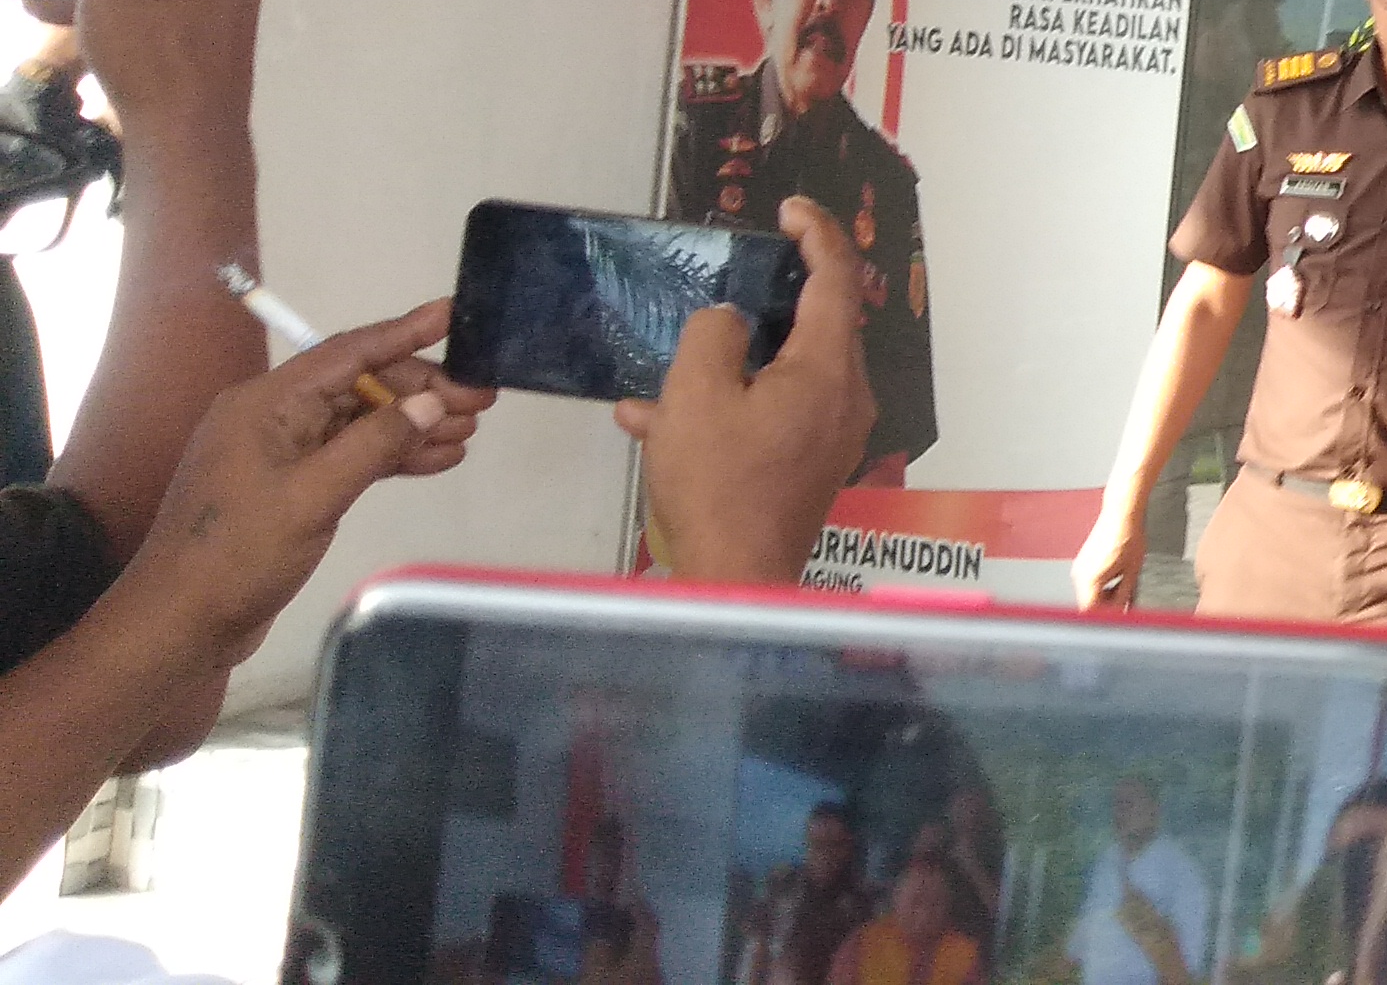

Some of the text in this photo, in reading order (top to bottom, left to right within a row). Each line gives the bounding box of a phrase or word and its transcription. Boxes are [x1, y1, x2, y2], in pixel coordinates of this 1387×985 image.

[1009, 4, 1180, 43] RASA KEADILAN
[887, 23, 1176, 75] YANG ADA DI MASYARAKAT.
